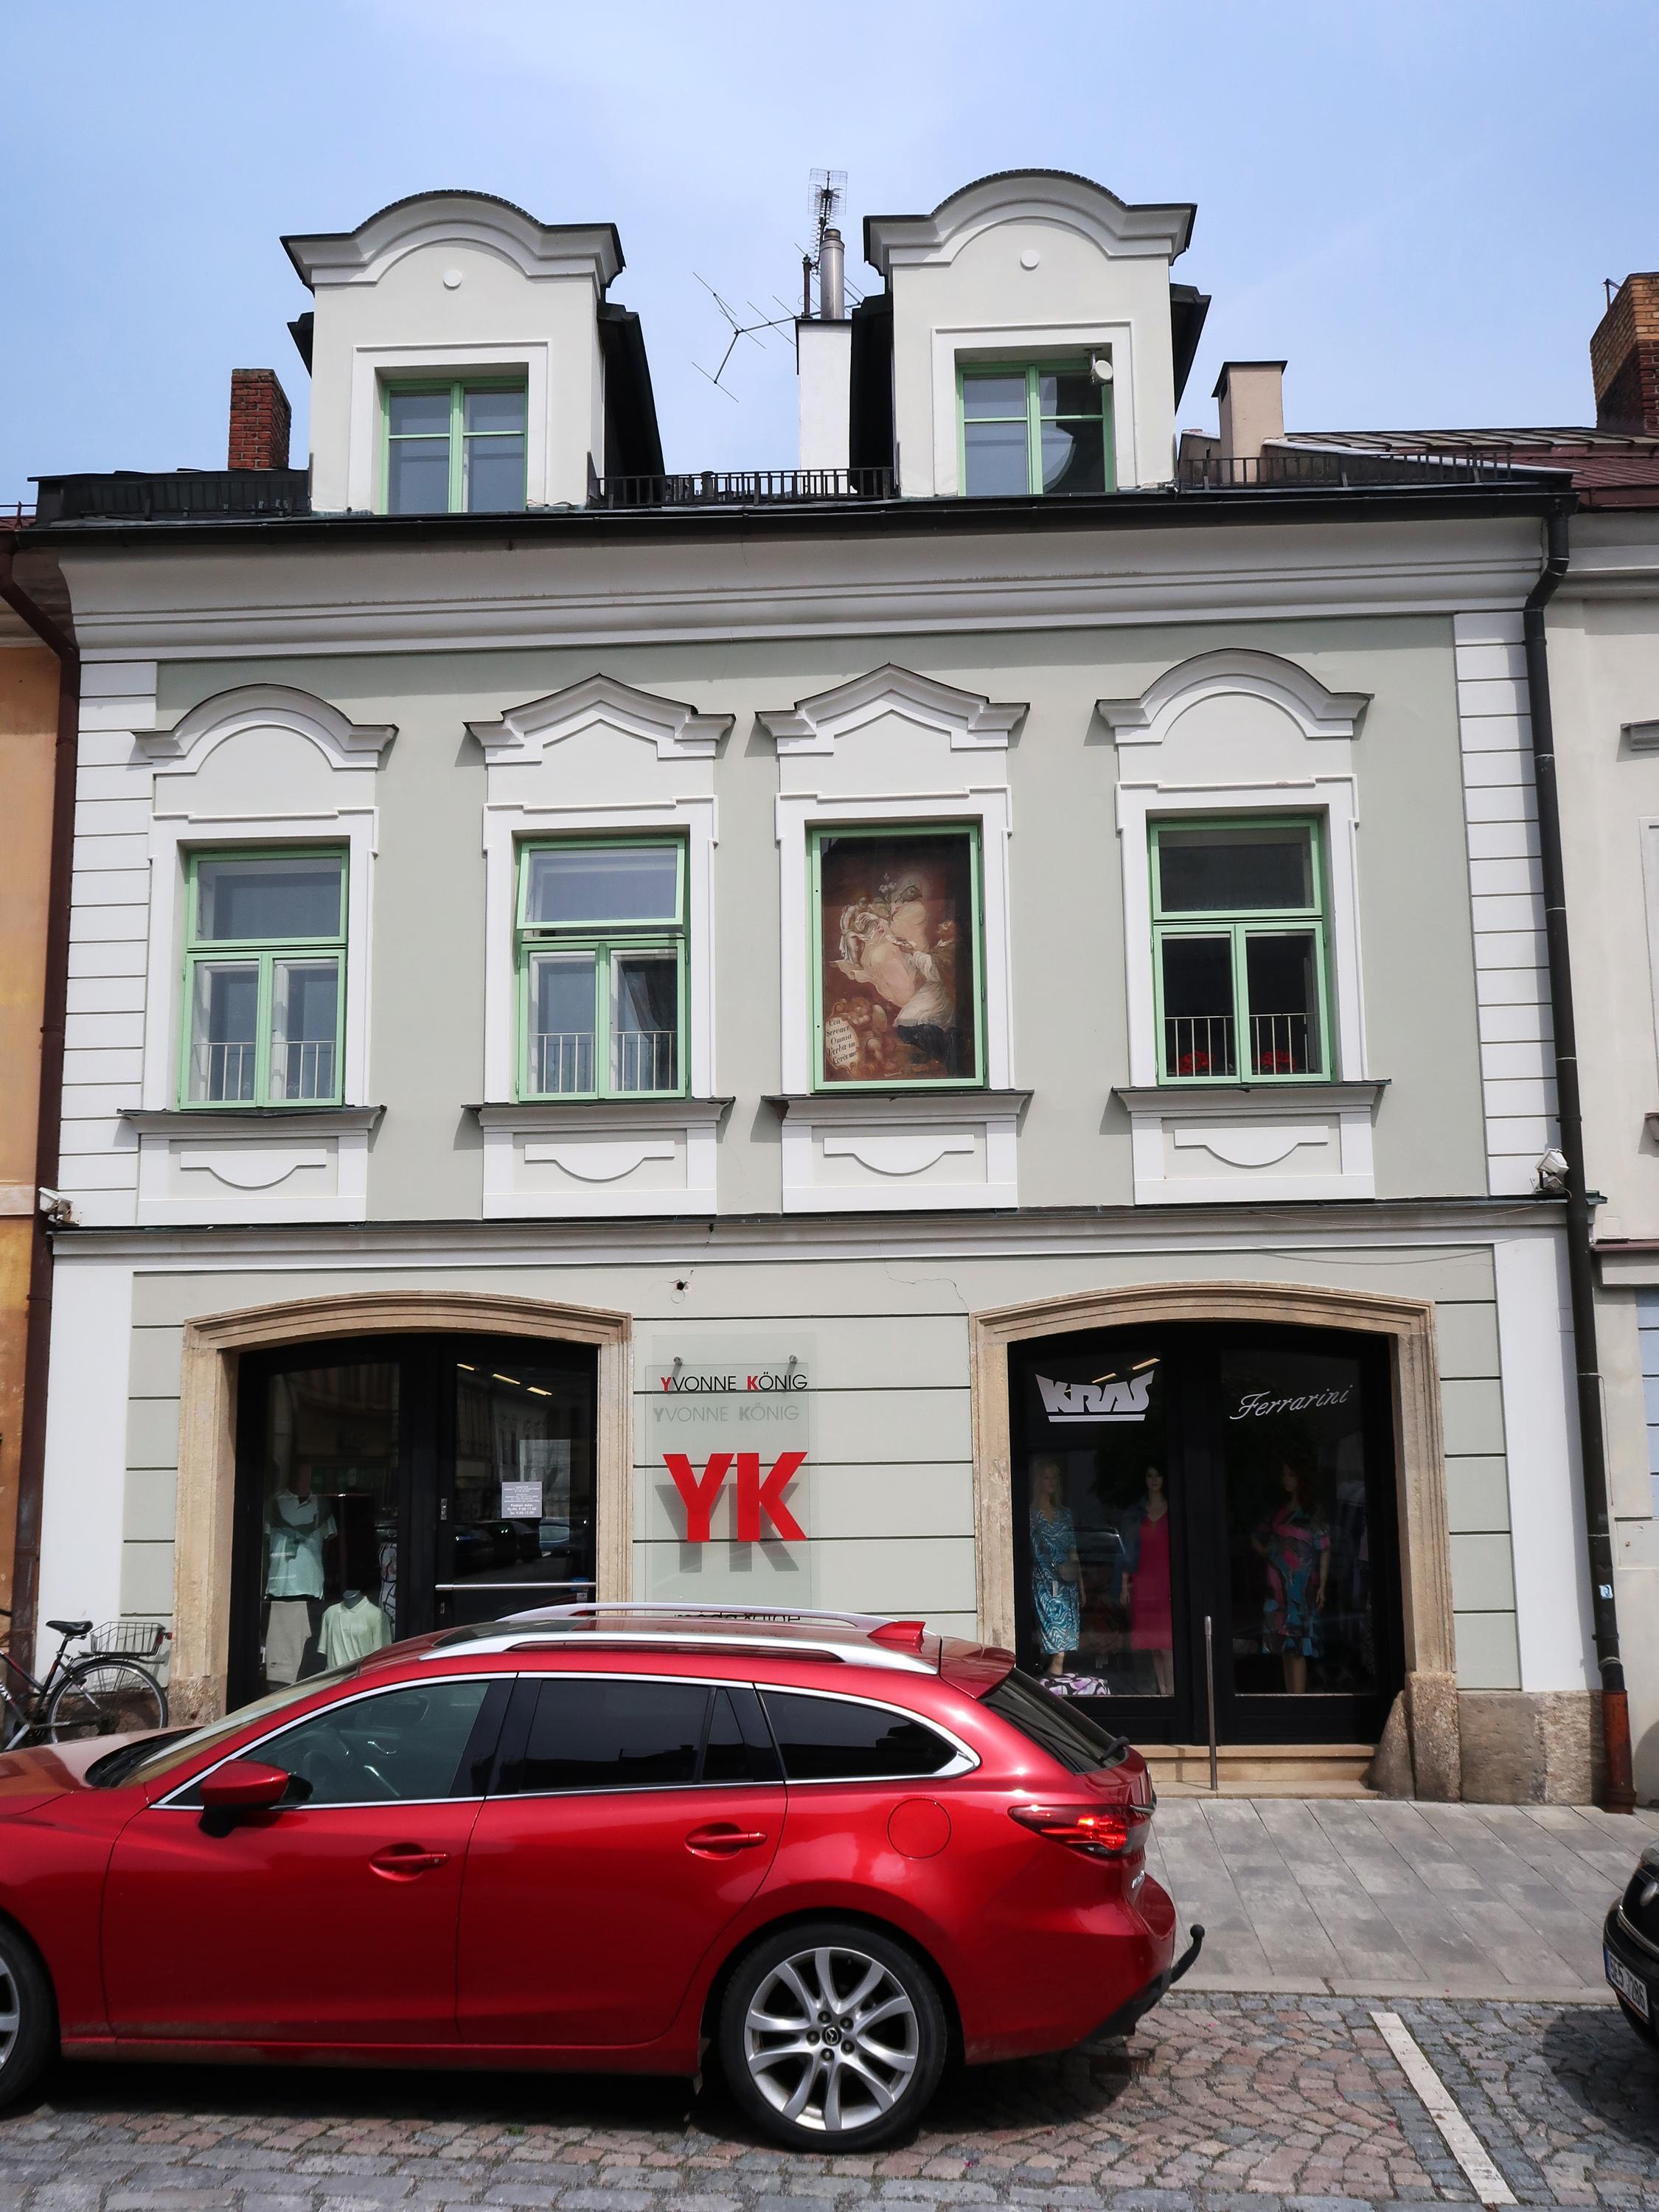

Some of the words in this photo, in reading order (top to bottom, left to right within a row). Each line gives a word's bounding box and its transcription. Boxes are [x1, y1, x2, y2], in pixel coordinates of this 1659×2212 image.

[661, 1376, 737, 1392] YVONNE
[747, 1371, 807, 1391] KÖNIG
[1035, 1370, 1154, 1413] KRAS
[1229, 1384, 1354, 1420] Ferrarini
[662, 1451, 808, 1543] YK
